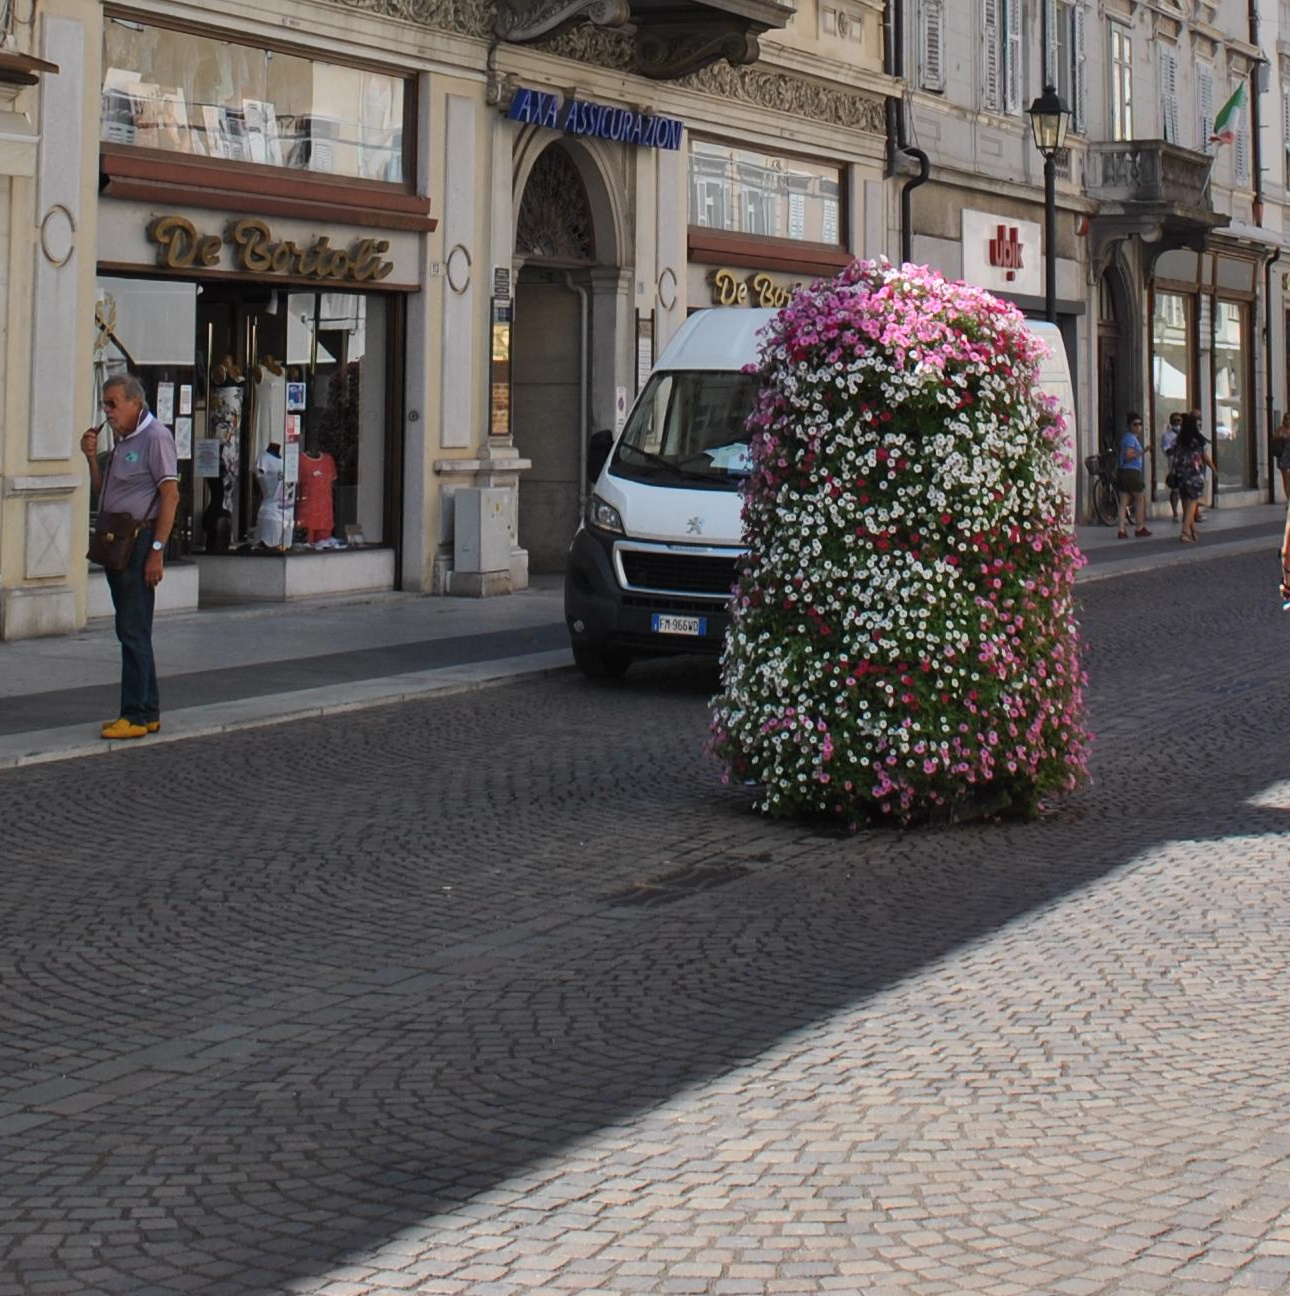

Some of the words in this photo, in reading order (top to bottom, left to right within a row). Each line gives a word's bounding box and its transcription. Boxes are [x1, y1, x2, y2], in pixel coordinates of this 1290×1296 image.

[518, 90, 558, 128] AXA
[149, 215, 222, 268] De
[229, 218, 394, 281] Bortoli
[712, 268, 747, 305] De
